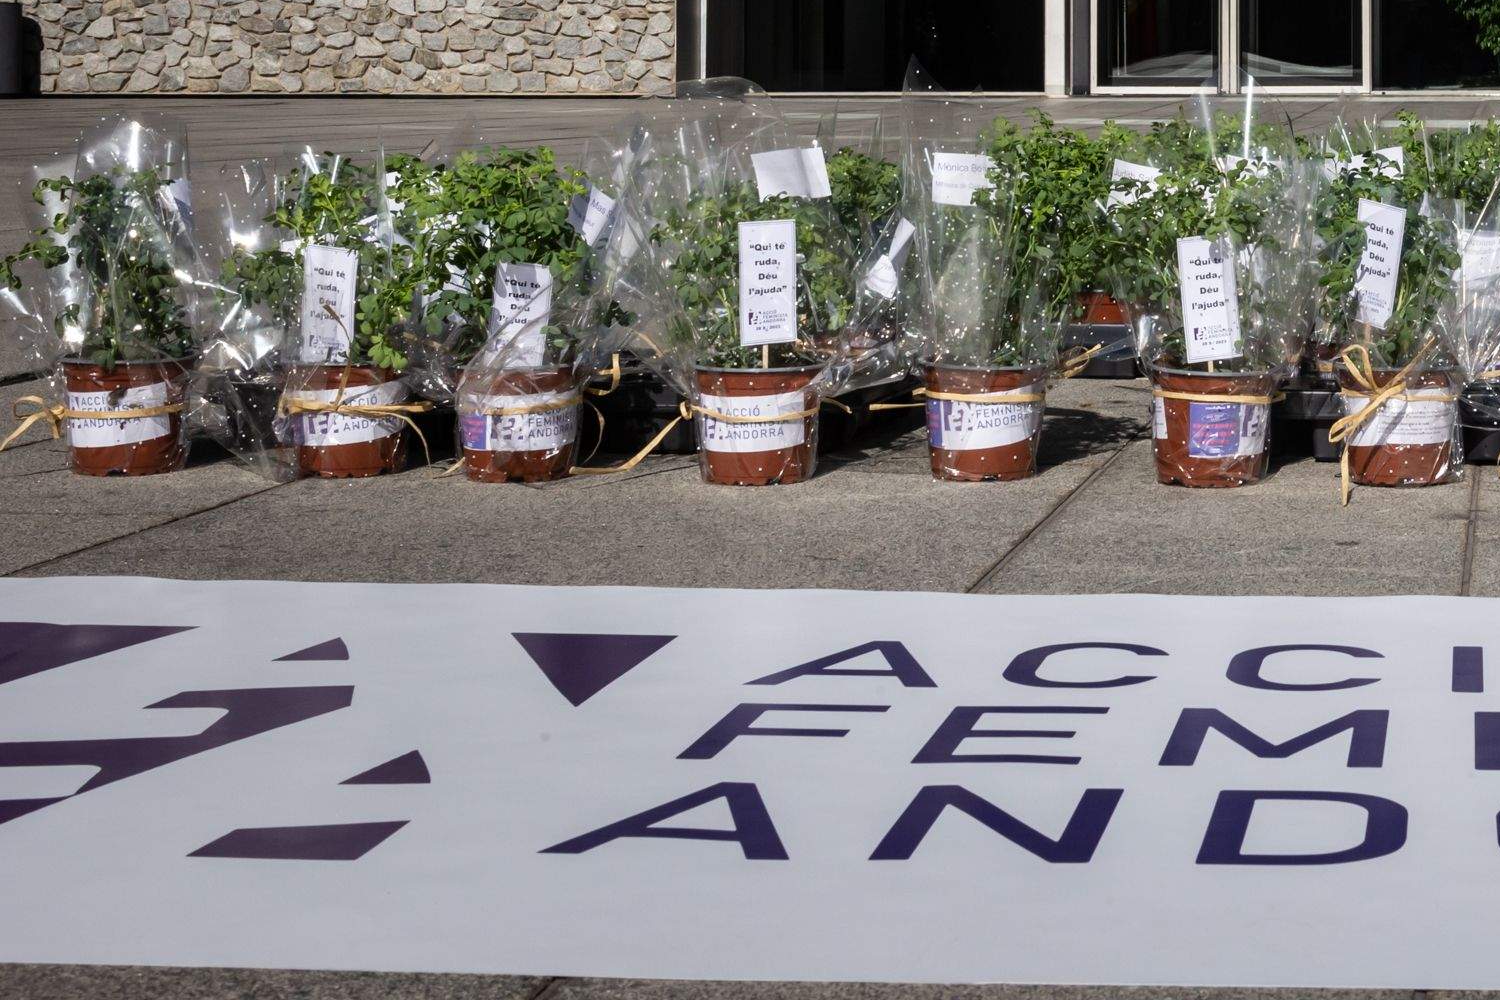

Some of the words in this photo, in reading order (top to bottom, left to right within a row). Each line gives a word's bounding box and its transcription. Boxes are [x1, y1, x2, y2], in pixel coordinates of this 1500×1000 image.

[755, 258, 781, 266] ruda,
[725, 405, 761, 417] ACCIÓ
[726, 428, 785, 440] ANDORRA
